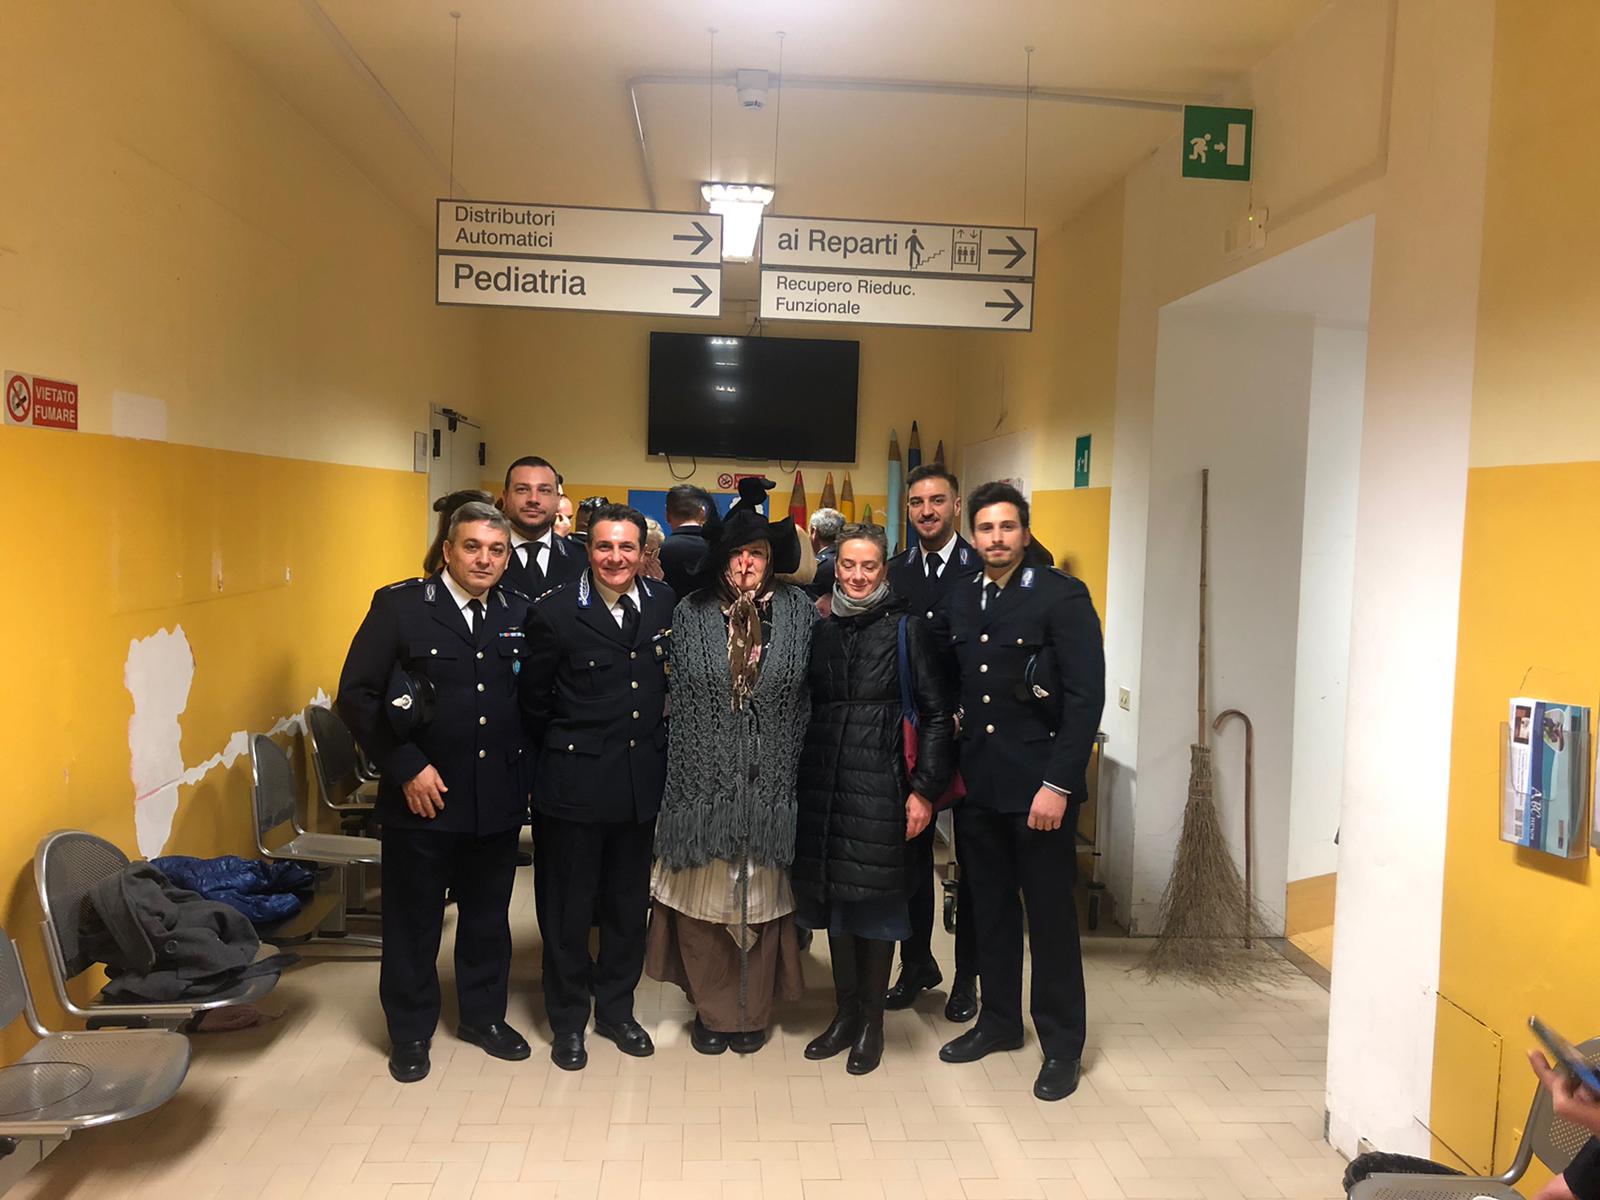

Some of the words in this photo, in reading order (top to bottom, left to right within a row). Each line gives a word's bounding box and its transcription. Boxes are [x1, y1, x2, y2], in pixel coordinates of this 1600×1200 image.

[455, 206, 555, 226] Distributori
[455, 227, 553, 248] Automatici
[777, 228, 799, 250] ai
[808, 229, 898, 259] Reparti
[453, 264, 586, 296] Pediatria
[776, 276, 852, 295] Recupero
[857, 278, 916, 296] Rieduc.
[776, 297, 860, 314] Funzionale
[35, 385, 75, 404] VIETATO
[34, 405, 76, 423] FUMARE
